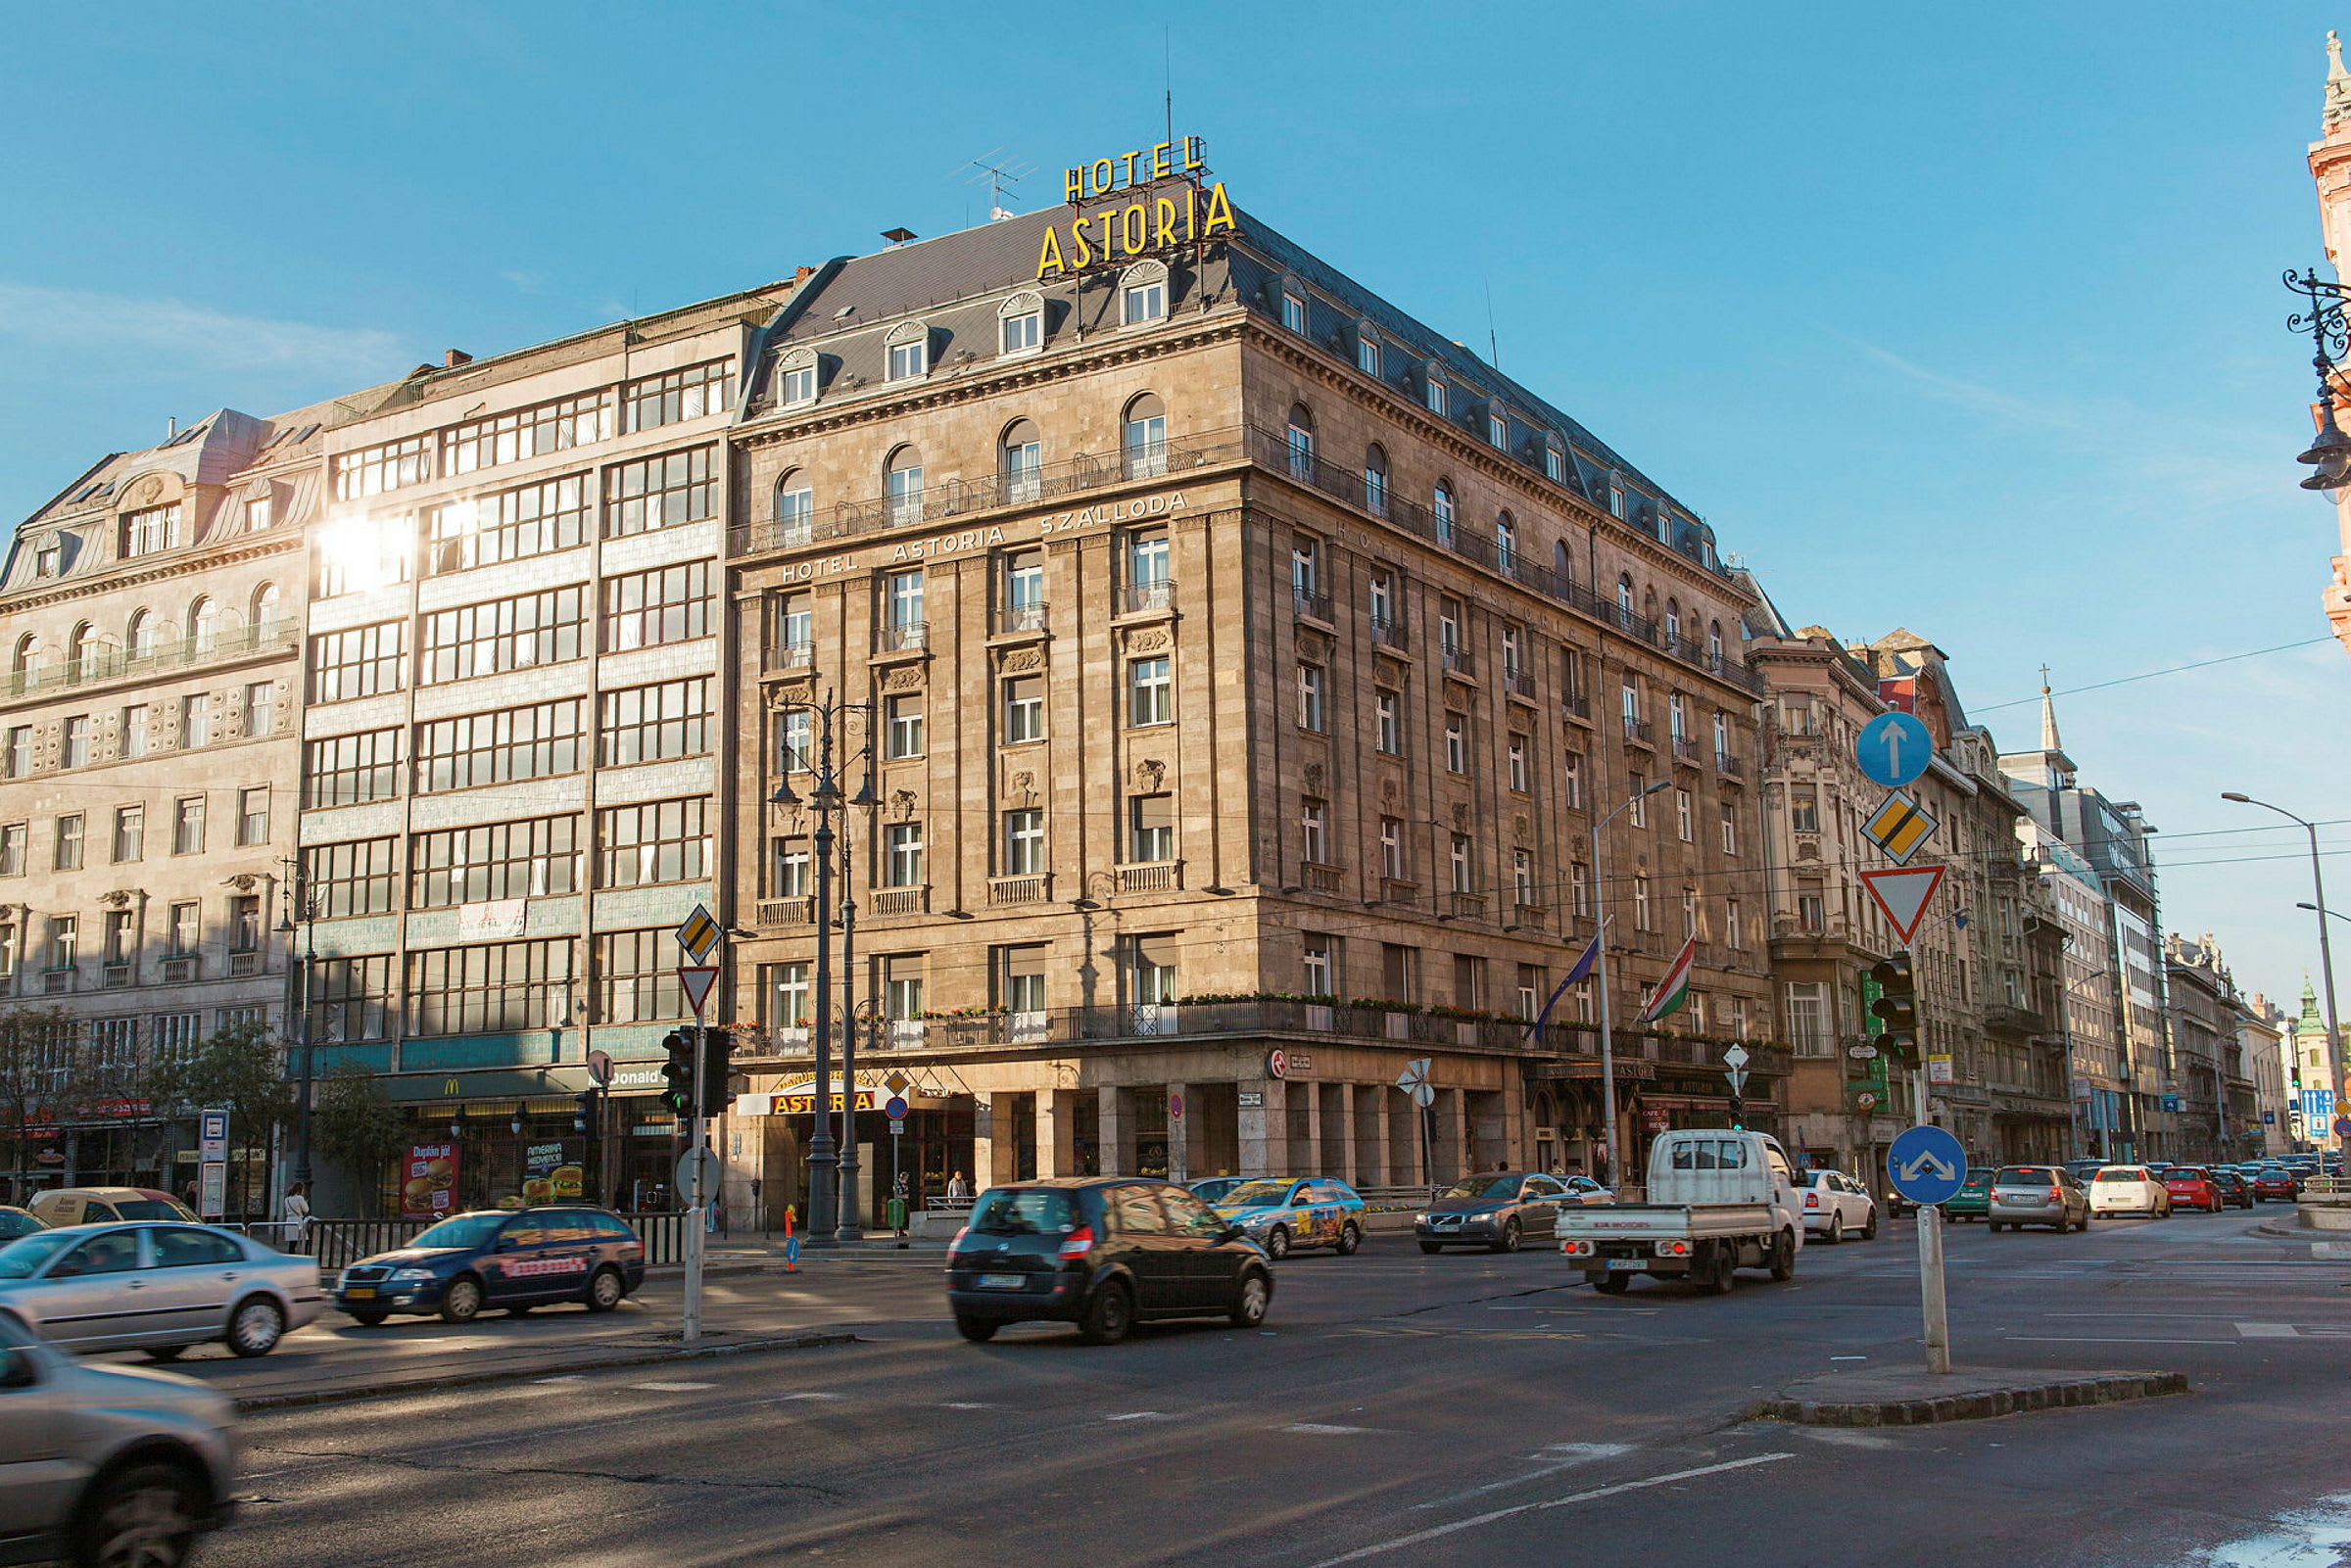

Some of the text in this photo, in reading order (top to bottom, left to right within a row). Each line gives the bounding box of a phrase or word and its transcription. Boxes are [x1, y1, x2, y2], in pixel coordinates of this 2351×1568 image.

[1065, 136, 1203, 202] HOTEL
[1036, 182, 1236, 279] ASTORIA
[783, 491, 1188, 583] HOTEL ASTORIA SZÁLLODA
[774, 1093, 872, 1114] ASTRA
